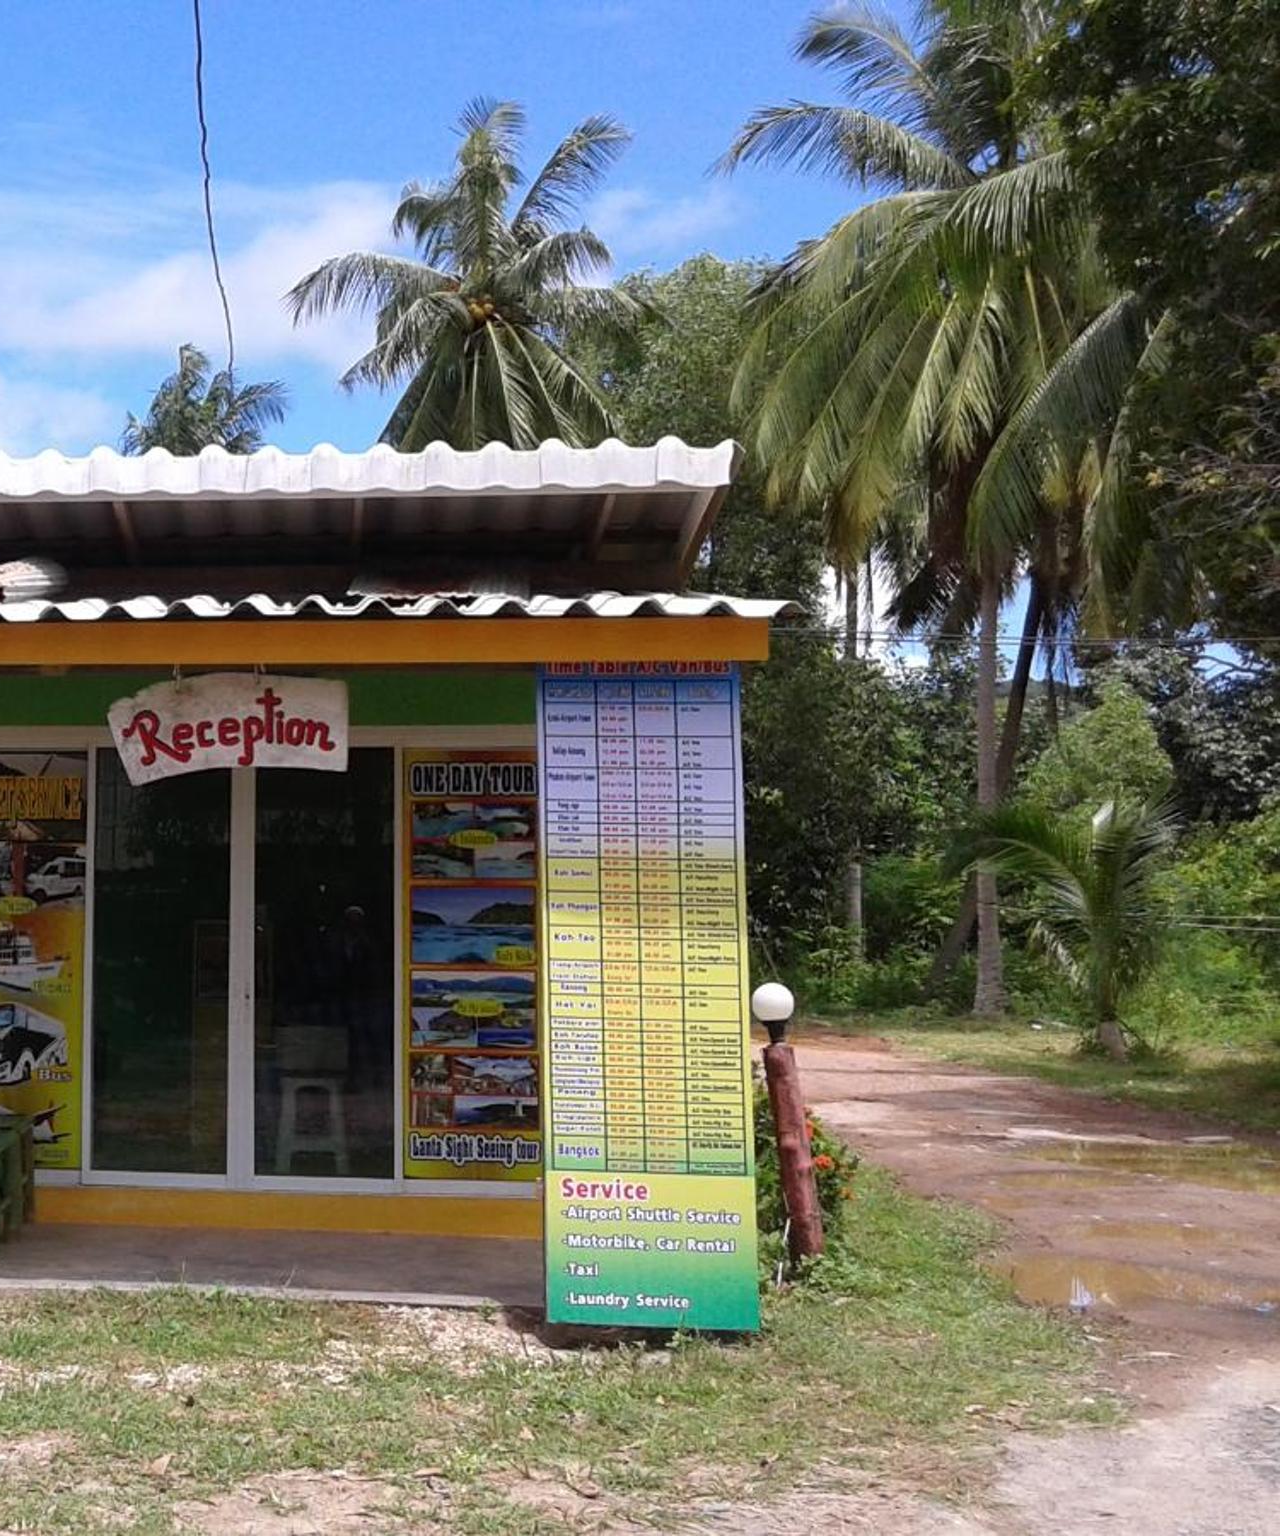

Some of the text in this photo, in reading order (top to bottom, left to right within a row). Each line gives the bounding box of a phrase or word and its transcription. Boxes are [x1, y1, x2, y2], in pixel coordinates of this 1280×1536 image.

[121, 687, 336, 767] Reception
[412, 765, 536, 793] ONE DAY TOUR
[38, 1069, 72, 1082] Bus
[411, 1134, 539, 1166] Lanta Sight Seeing tour
[558, 1143, 600, 1158] Bangkok
[562, 1178, 648, 1200] Service
[562, 1206, 741, 1225] -Airport Shuttle Service
[656, 1237, 681, 1251] Car
[686, 1238, 736, 1253] Rental
[564, 1262, 600, 1277] -Taxi
[565, 1293, 691, 1310] -Laundry Service
